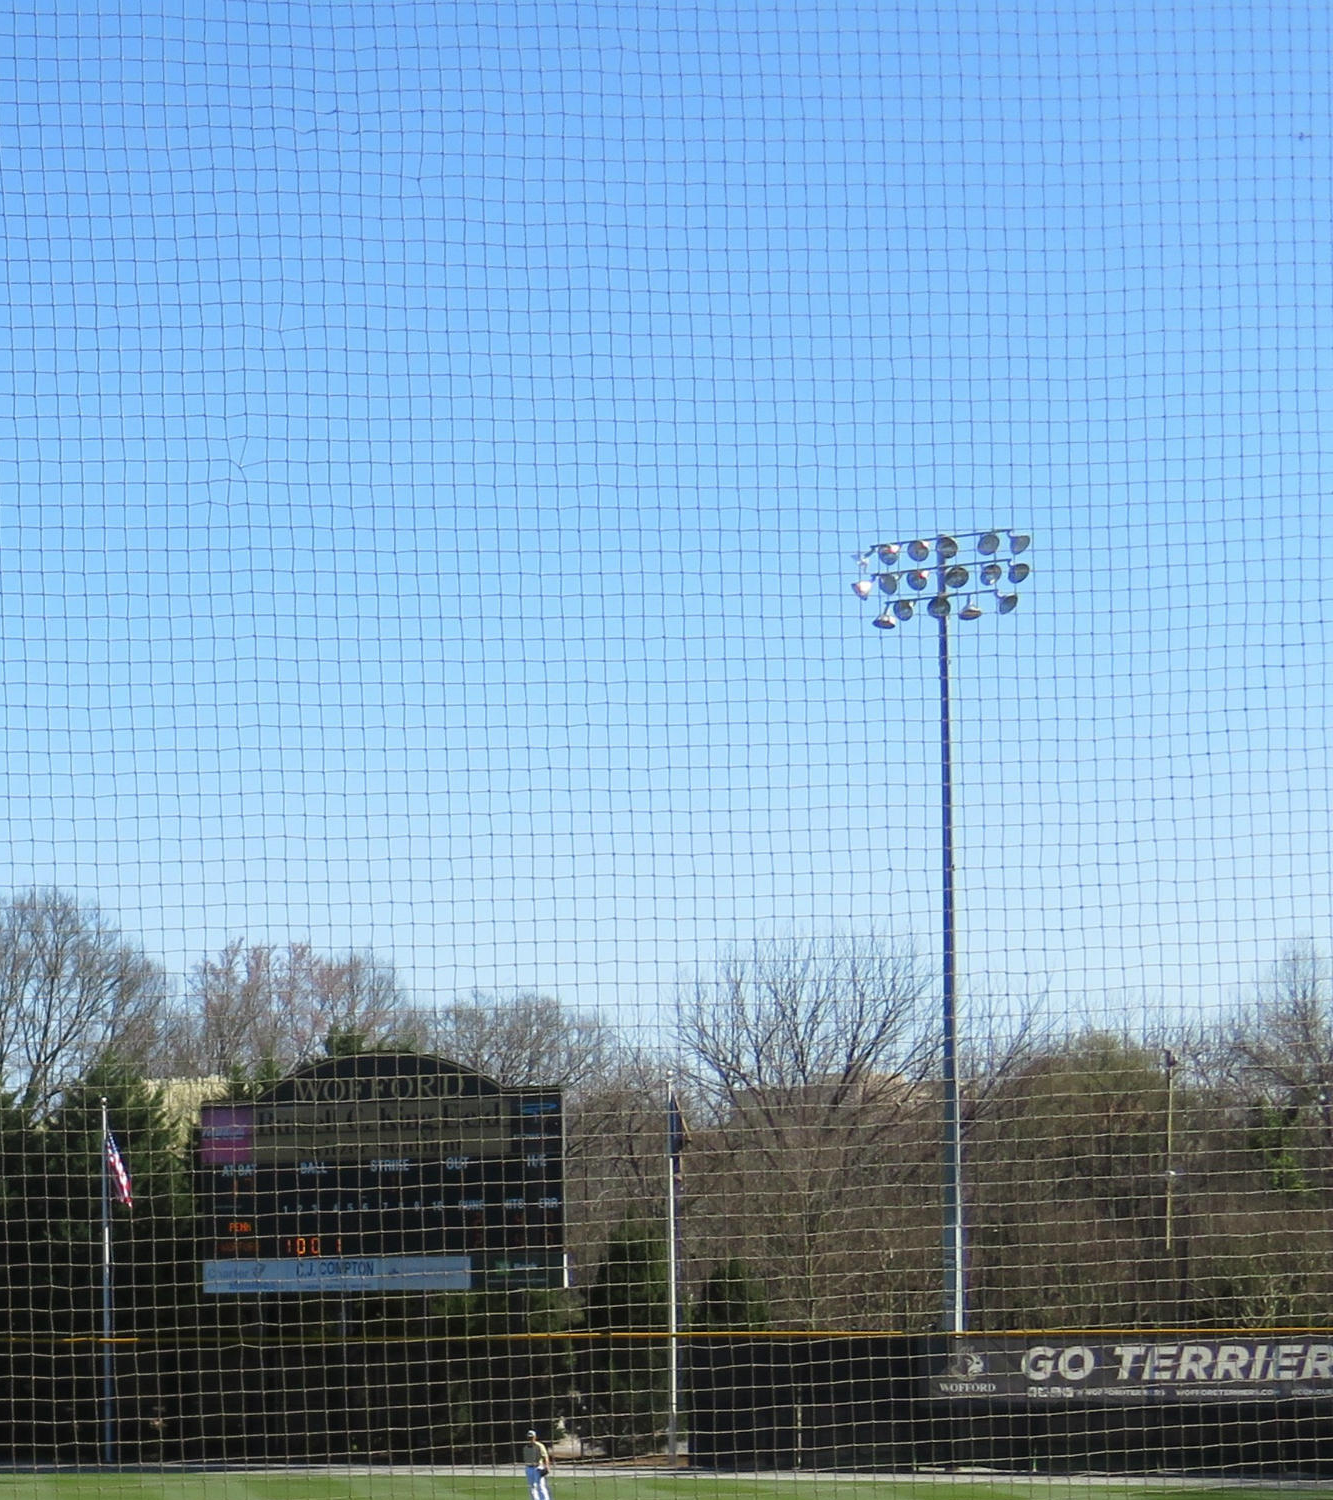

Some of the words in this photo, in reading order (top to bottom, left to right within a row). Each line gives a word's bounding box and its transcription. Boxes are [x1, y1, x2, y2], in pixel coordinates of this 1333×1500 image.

[295, 1075, 465, 1102] WOFFORD
[300, 1162, 327, 1174] BALL
[370, 1159, 410, 1172] STRIKE
[446, 1157, 469, 1169] OUT
[319, 1260, 374, 1276] COMPTON
[1021, 1346, 1095, 1381] GO
[1114, 1345, 1333, 1381] TERRIER
[939, 1382, 996, 1393] WOFFORD
